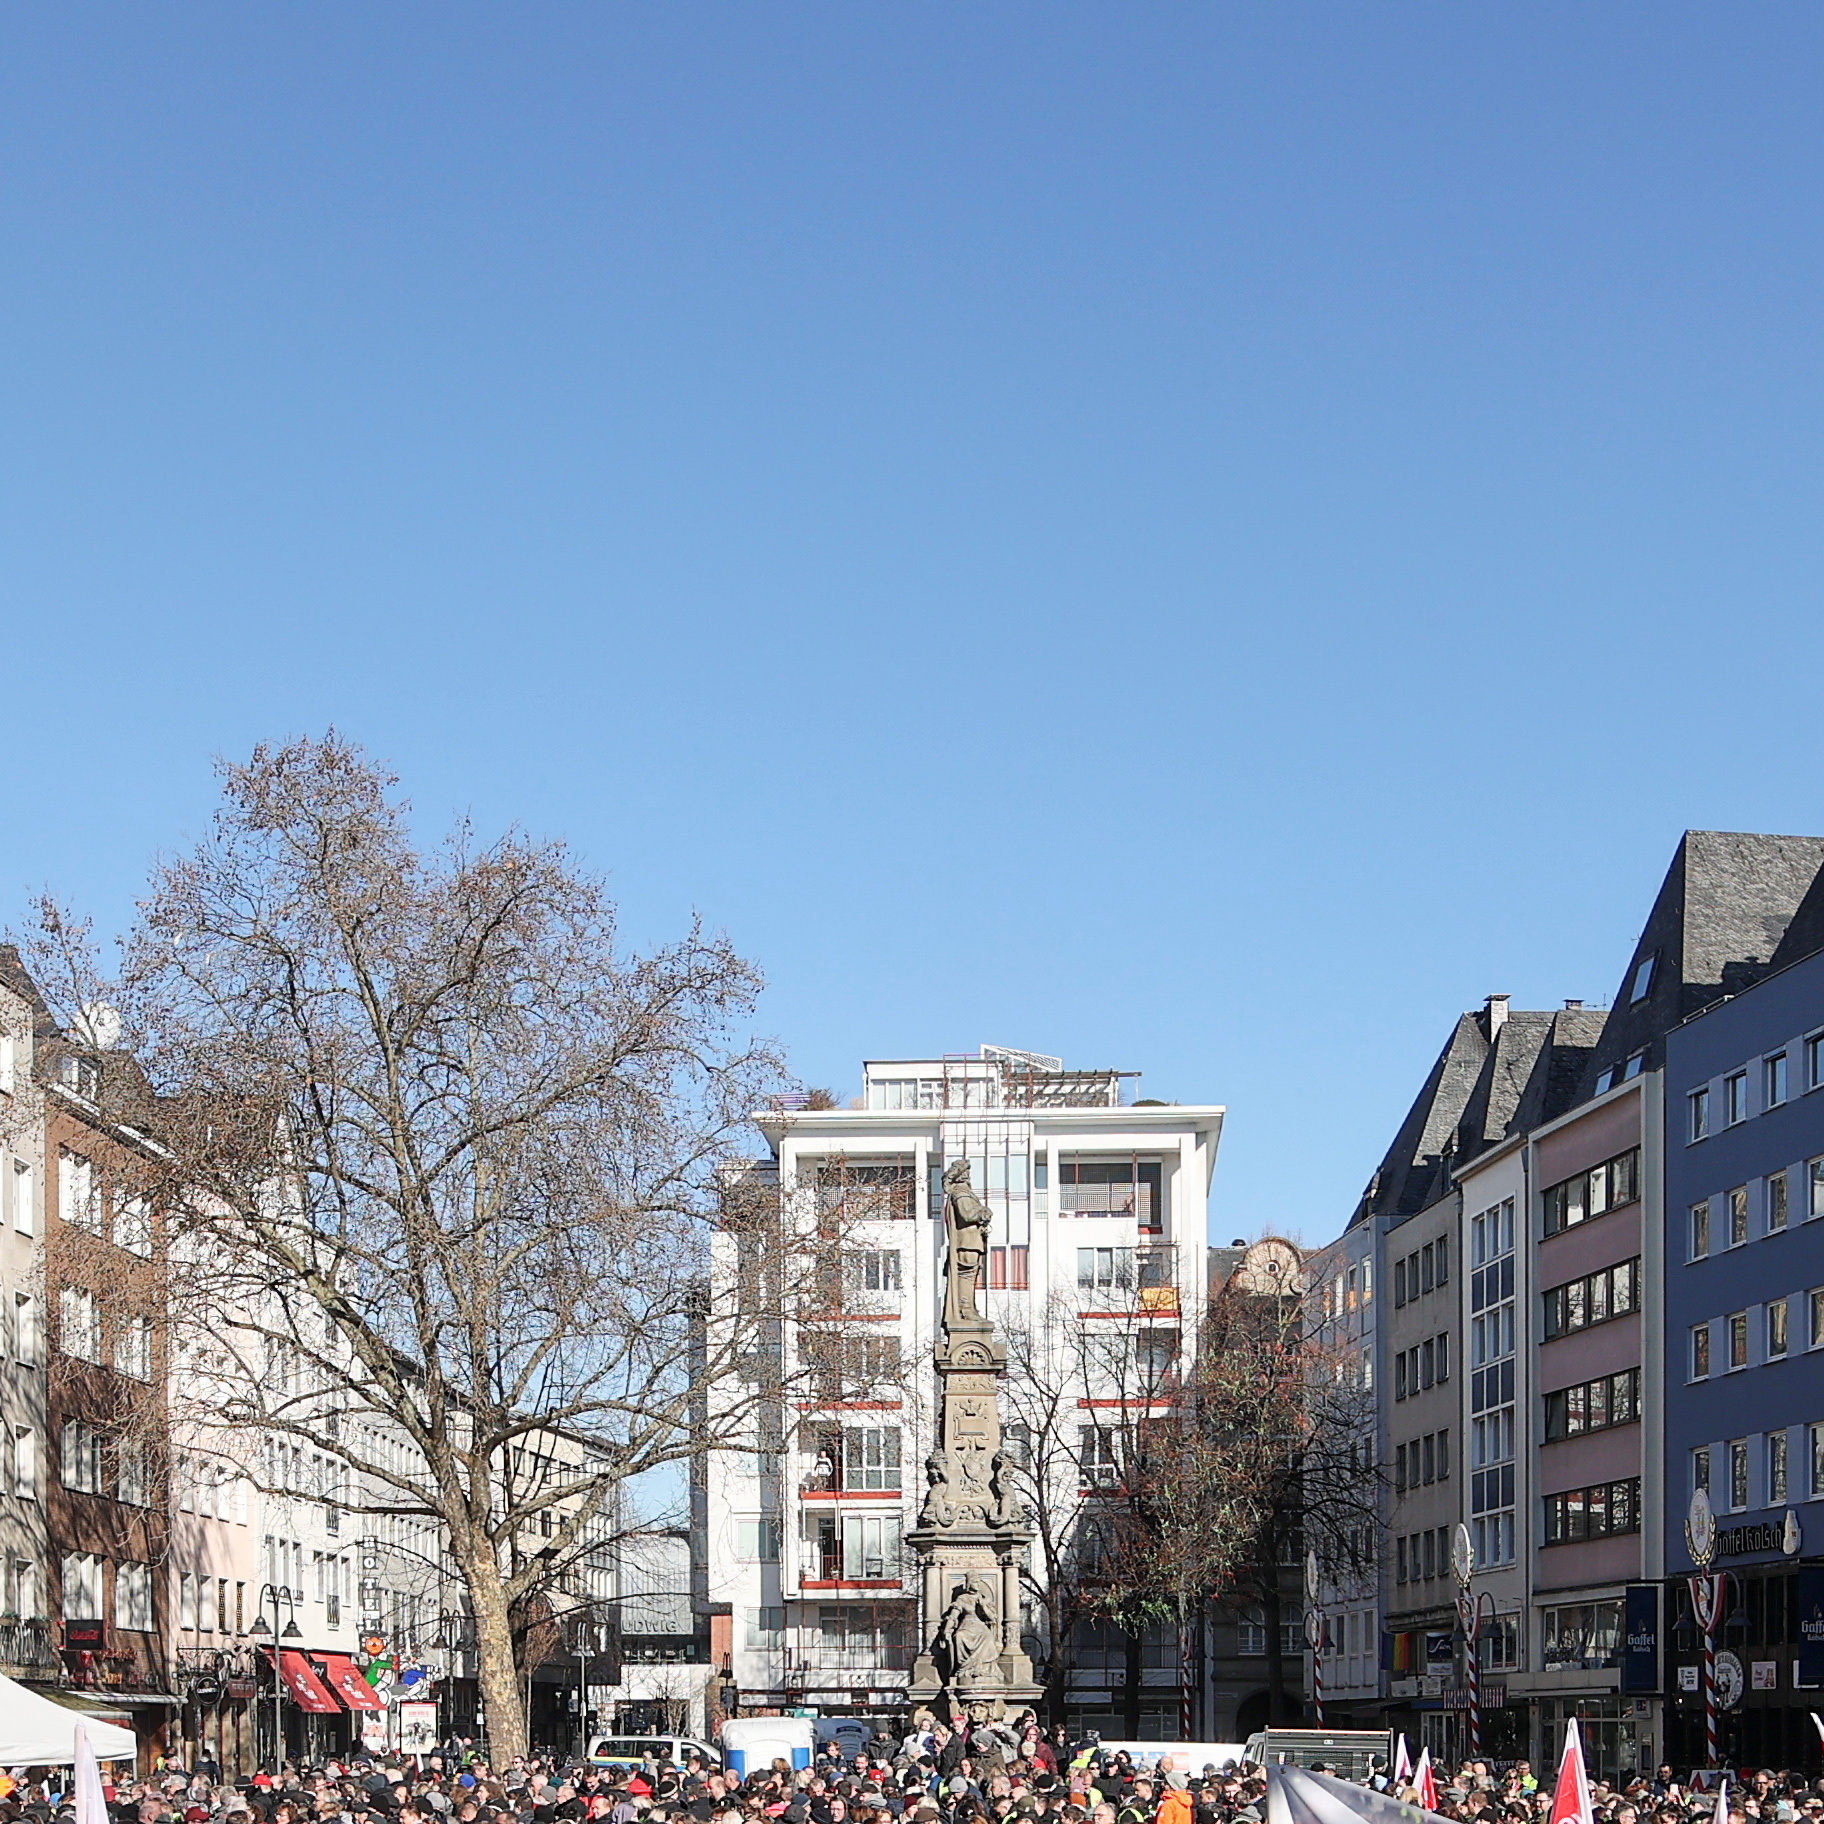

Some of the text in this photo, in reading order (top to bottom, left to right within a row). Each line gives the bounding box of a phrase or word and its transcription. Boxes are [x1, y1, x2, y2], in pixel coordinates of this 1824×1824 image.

[362, 1535, 380, 1633] HOTEL
[621, 1620, 678, 1633] UDWIG
[1628, 1633, 1655, 1646] Gaffel
